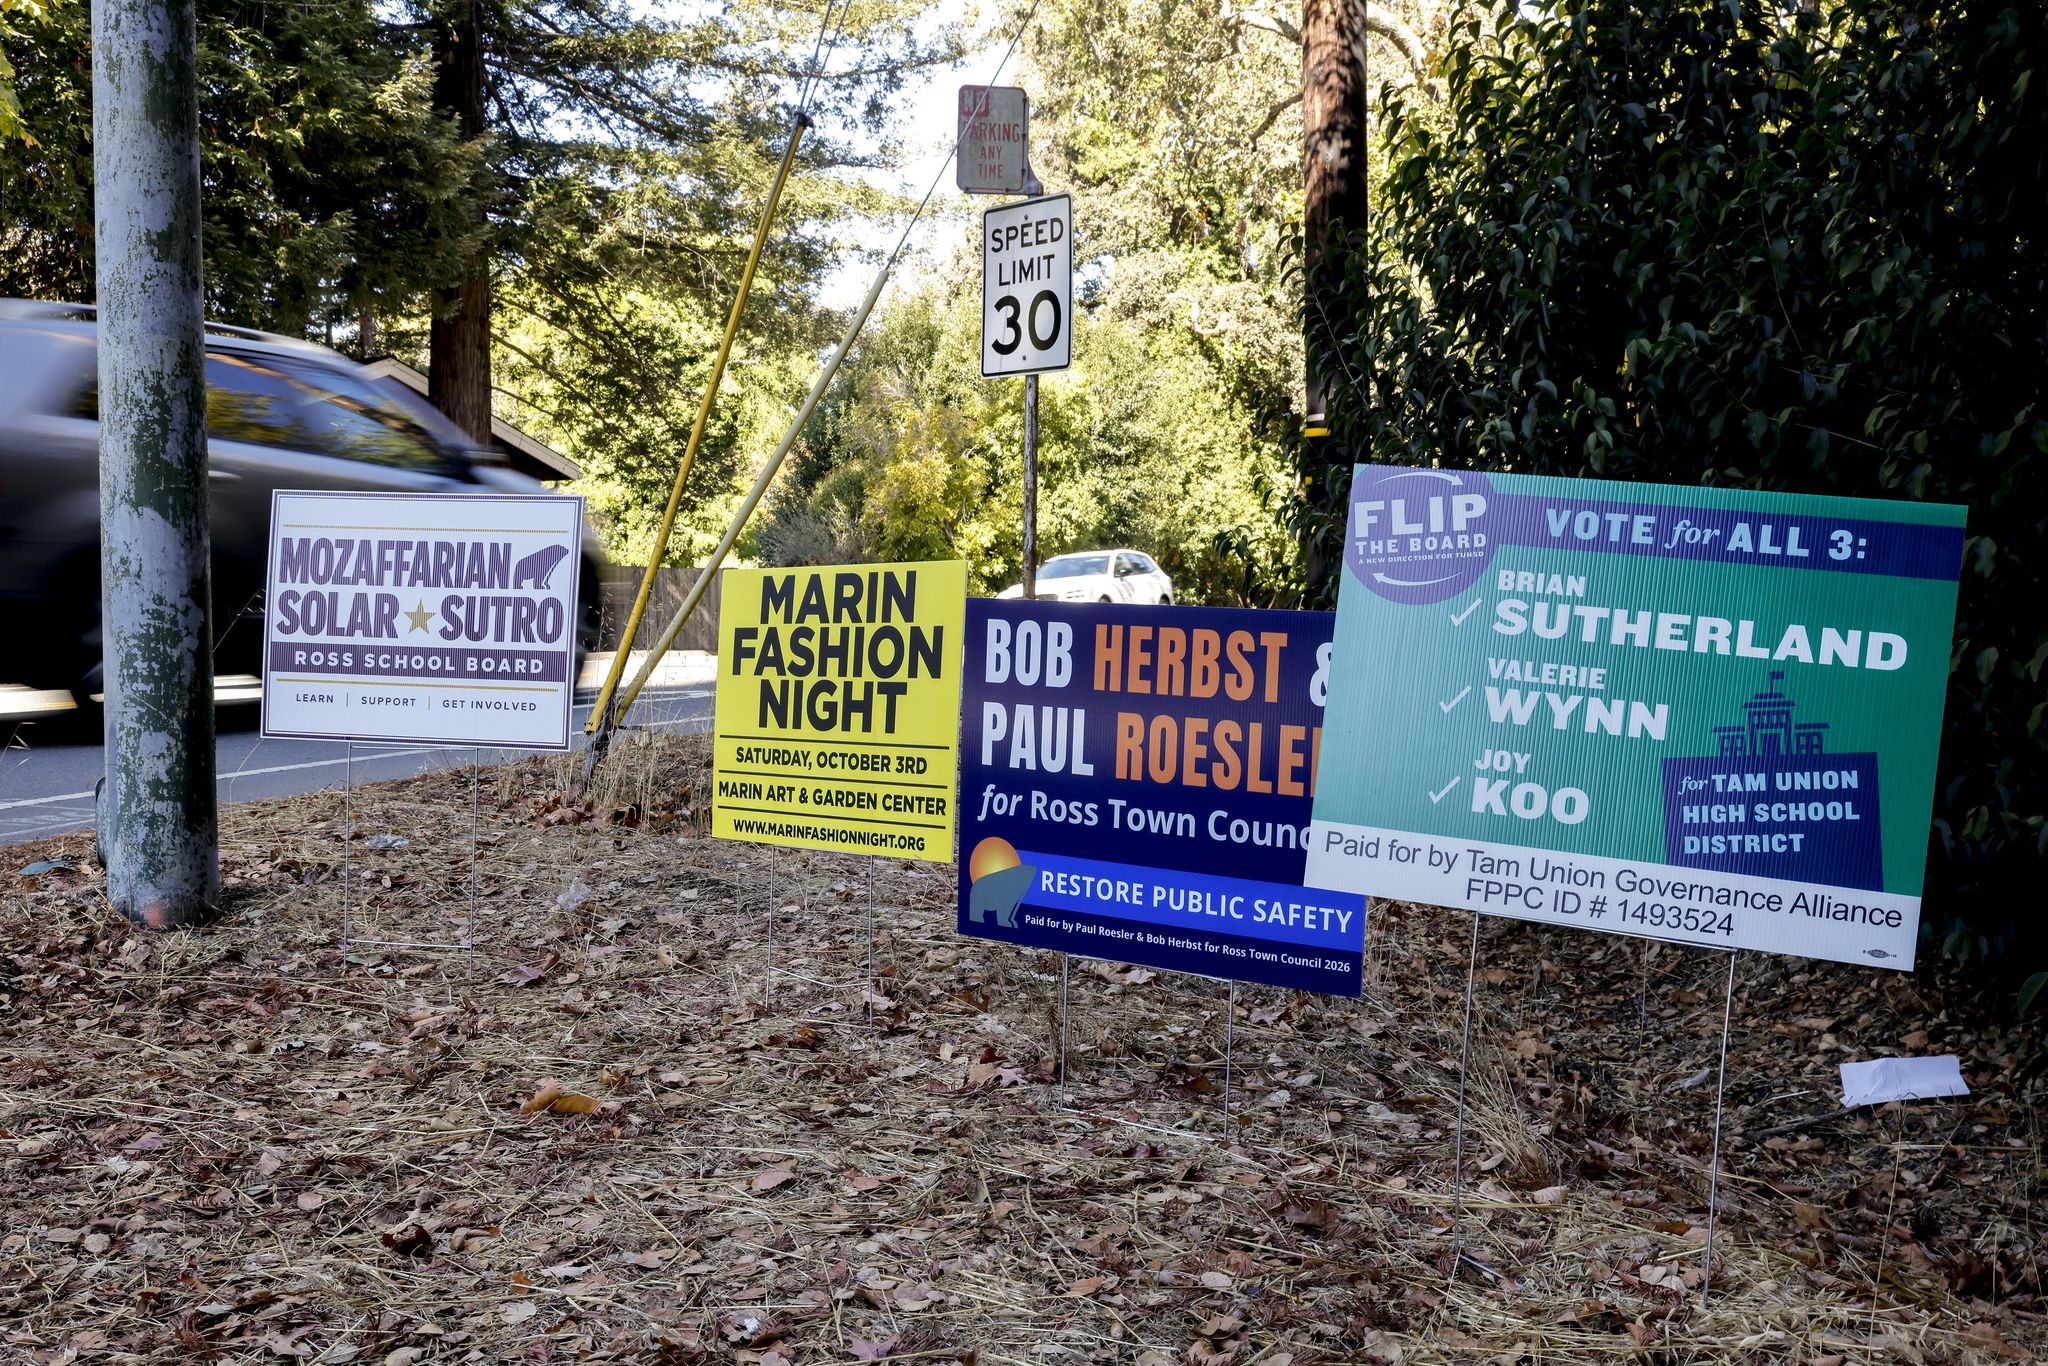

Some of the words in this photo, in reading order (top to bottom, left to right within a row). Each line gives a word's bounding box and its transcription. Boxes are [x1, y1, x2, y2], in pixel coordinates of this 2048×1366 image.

[963, 90, 986, 113] NO
[963, 121, 1020, 142] PARKING
[980, 145, 1003, 160] ANY
[978, 164, 1004, 179] TIME
[991, 217, 1064, 253] SPEED
[998, 254, 1055, 287] LIMIT
[991, 289, 1061, 356] 30
[1354, 493, 1487, 538] FLIP
[1355, 539, 1398, 555] THE
[1410, 533, 1487, 552] BOARD
[1546, 508, 1656, 545] VOTE
[1664, 519, 1720, 549] for
[1727, 522, 1810, 557] ALL
[1828, 529, 1867, 561] 3:
[279, 537, 512, 590] MOZAFFARIAN
[1388, 554, 1433, 563] DIRECTION
[760, 570, 917, 625] MARIN
[1498, 569, 1585, 597] BRIAN
[276, 590, 399, 639] SOLAR
[438, 595, 564, 644] SUTRO
[1492, 599, 1908, 671] SUTHERLAND
[294, 651, 353, 668] ROSS
[364, 653, 455, 671] SCHOOL
[466, 657, 544, 674] BOARD
[732, 625, 944, 679] FASHION
[985, 618, 1074, 688] BOB
[1093, 623, 1288, 703] HERBST
[1488, 657, 1607, 690] VALERIE
[296, 693, 334, 704] LEARN
[361, 696, 417, 707] SUPPORT
[442, 699, 466, 710] GET
[470, 700, 537, 712] INVOLVED
[758, 678, 908, 734] NIGHT
[1485, 686, 1669, 741] WYNN
[981, 701, 1095, 777] PAUL
[736, 747, 812, 771] SATURDAY,
[816, 752, 891, 773] OCTOBER
[895, 755, 927, 775] 3RD
[1475, 749, 1531, 774] JOY
[718, 781, 762, 801] MARIN
[765, 785, 795, 802] ART
[799, 787, 809, 804] &
[812, 788, 877, 810] GARDEN
[882, 793, 947, 816] CENTER
[1677, 776, 1708, 795] for
[1711, 773, 1766, 792] TAM
[1775, 770, 1858, 791] UNION
[977, 784, 1023, 822] for
[1031, 791, 1099, 827] Ross
[1108, 799, 1196, 838] Town
[1471, 777, 1590, 825] KOO
[1682, 804, 1745, 824] HIGH
[1754, 801, 1860, 823] SCHOOL
[733, 818, 925, 851] WWW.MARINFASHIONNIGHT.ORG
[1684, 833, 1805, 854] DISTRICT
[1325, 831, 1380, 859] Paid
[1388, 839, 1422, 864] for
[1428, 844, 1459, 874] by
[1466, 848, 1520, 877] Tam
[1530, 857, 1605, 889] Union
[1615, 869, 1783, 912] Governance
[1789, 892, 1903, 928] Alliance
[1041, 870, 1144, 905] RESTORE
[1153, 885, 1245, 920] PUBLIC
[1253, 899, 1353, 933] SAFETY
[1466, 878, 1544, 910] FPPC
[1553, 890, 1582, 914] ID
[1589, 895, 1607, 918] #
[1617, 899, 1734, 936] 1493524
[1025, 914, 1044, 926] Paid
[1047, 917, 1060, 929] for
[1062, 919, 1074, 933] by
[1075, 922, 1096, 935] Paul
[1098, 926, 1135, 940] Roesler
[1136, 931, 1144, 942] &
[1146, 933, 1165, 945] Bob
[1168, 937, 1202, 951] Herbst
[1204, 941, 1220, 953] for
[1222, 944, 1246, 958] Ross
[1249, 948, 1278, 962] Town
[1280, 953, 1322, 969] Council
[1324, 959, 1350, 973] 2026
